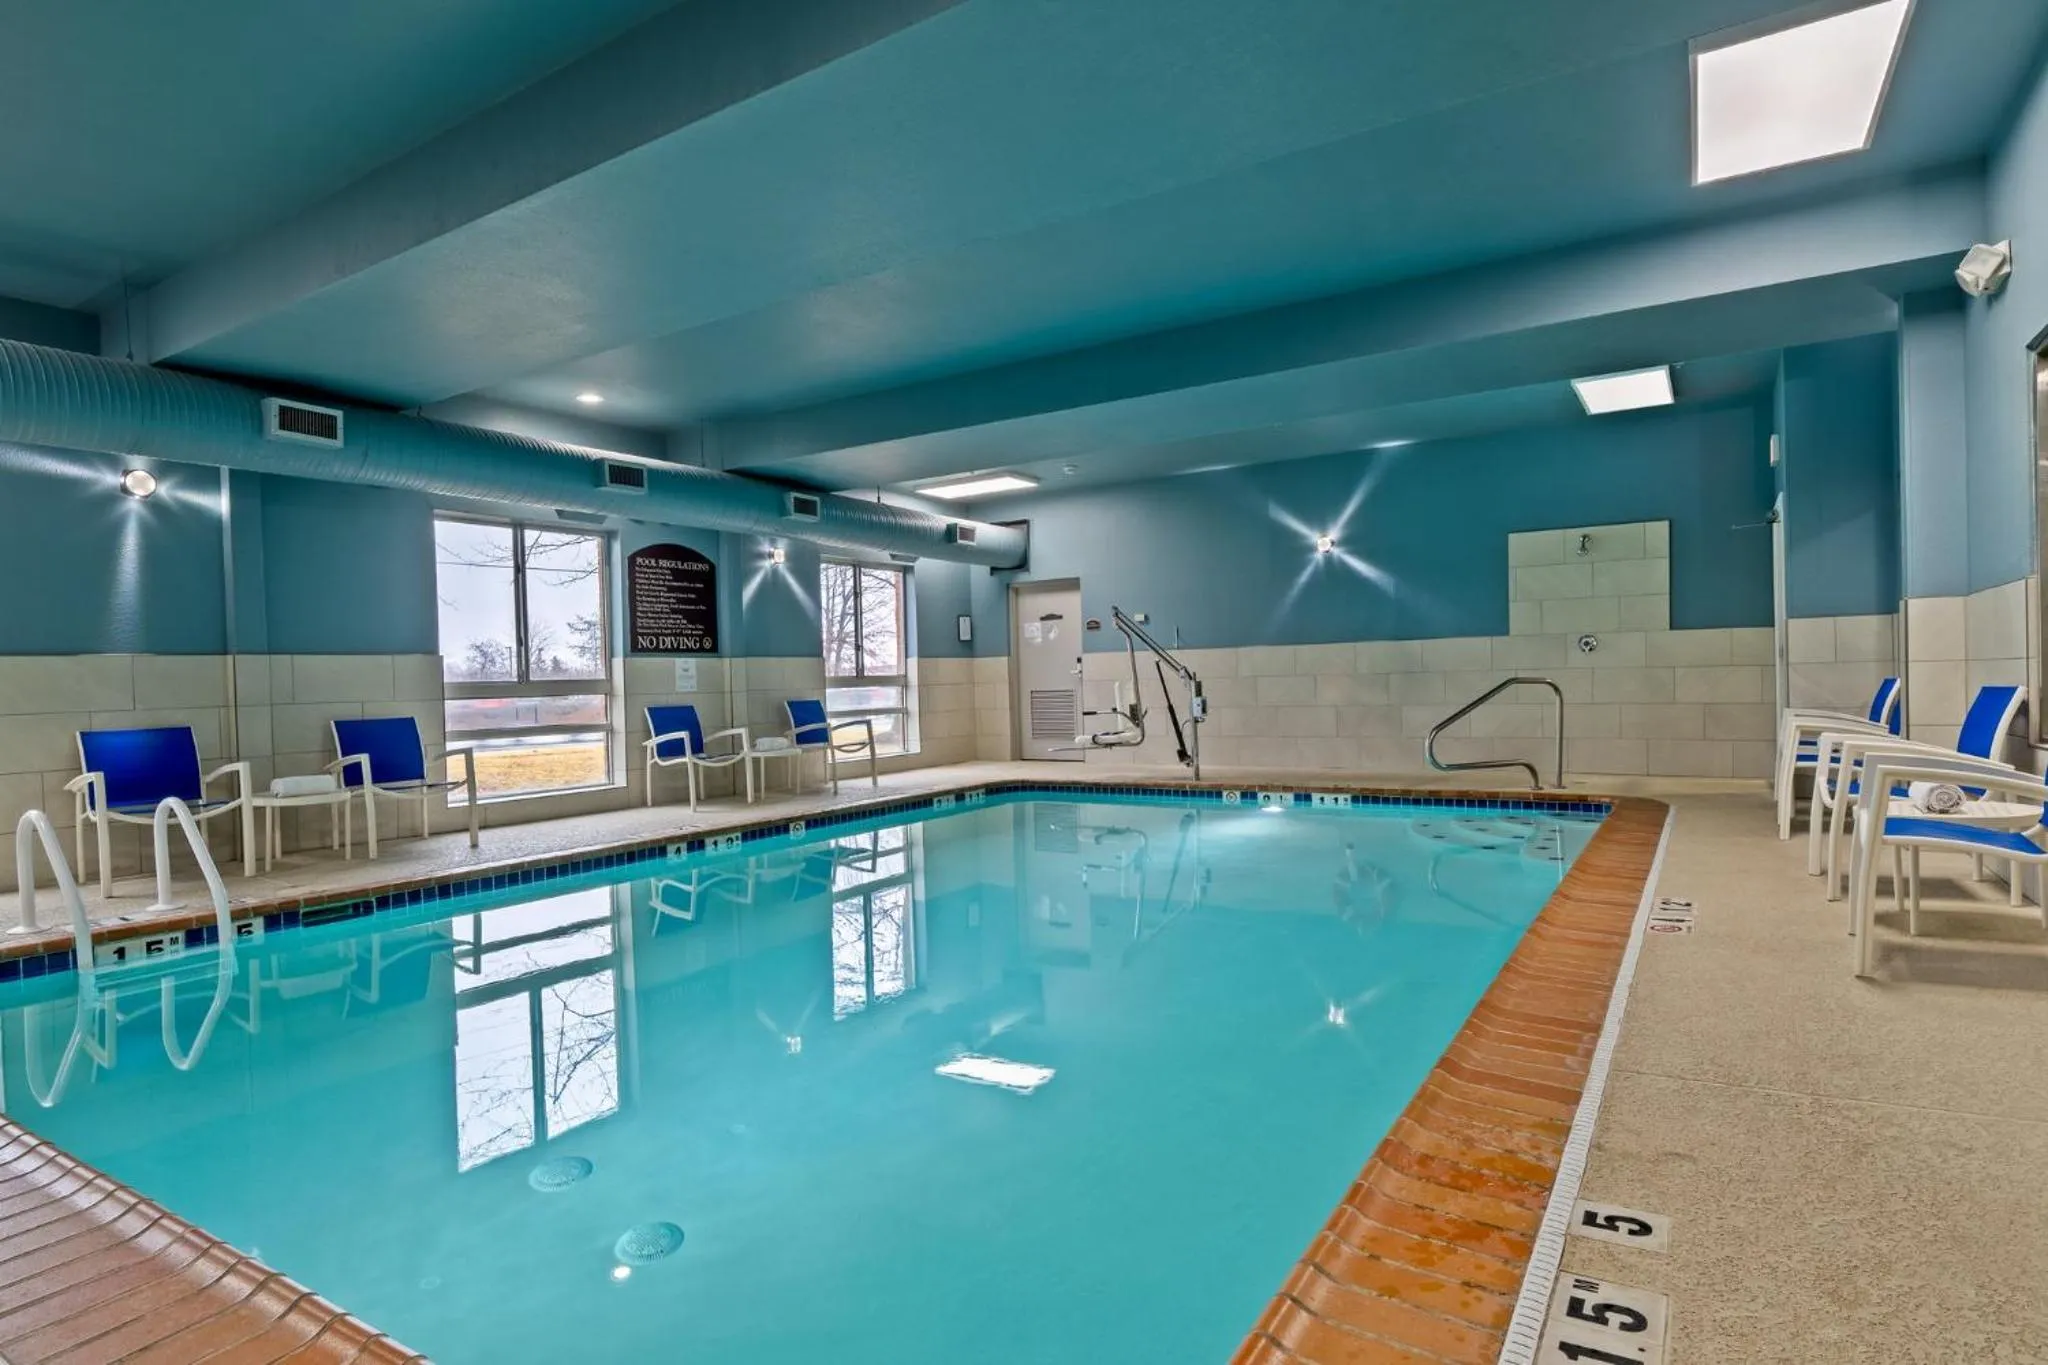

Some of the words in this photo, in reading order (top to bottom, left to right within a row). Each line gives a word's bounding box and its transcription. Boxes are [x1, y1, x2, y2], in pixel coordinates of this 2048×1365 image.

[635, 557, 657, 567] POOL
[659, 559, 710, 572] REGULATIONS
[638, 635, 657, 649] NO
[659, 635, 700, 649] DIVING
[237, 922, 255, 937] 5
[1582, 1209, 1653, 1237] 5
